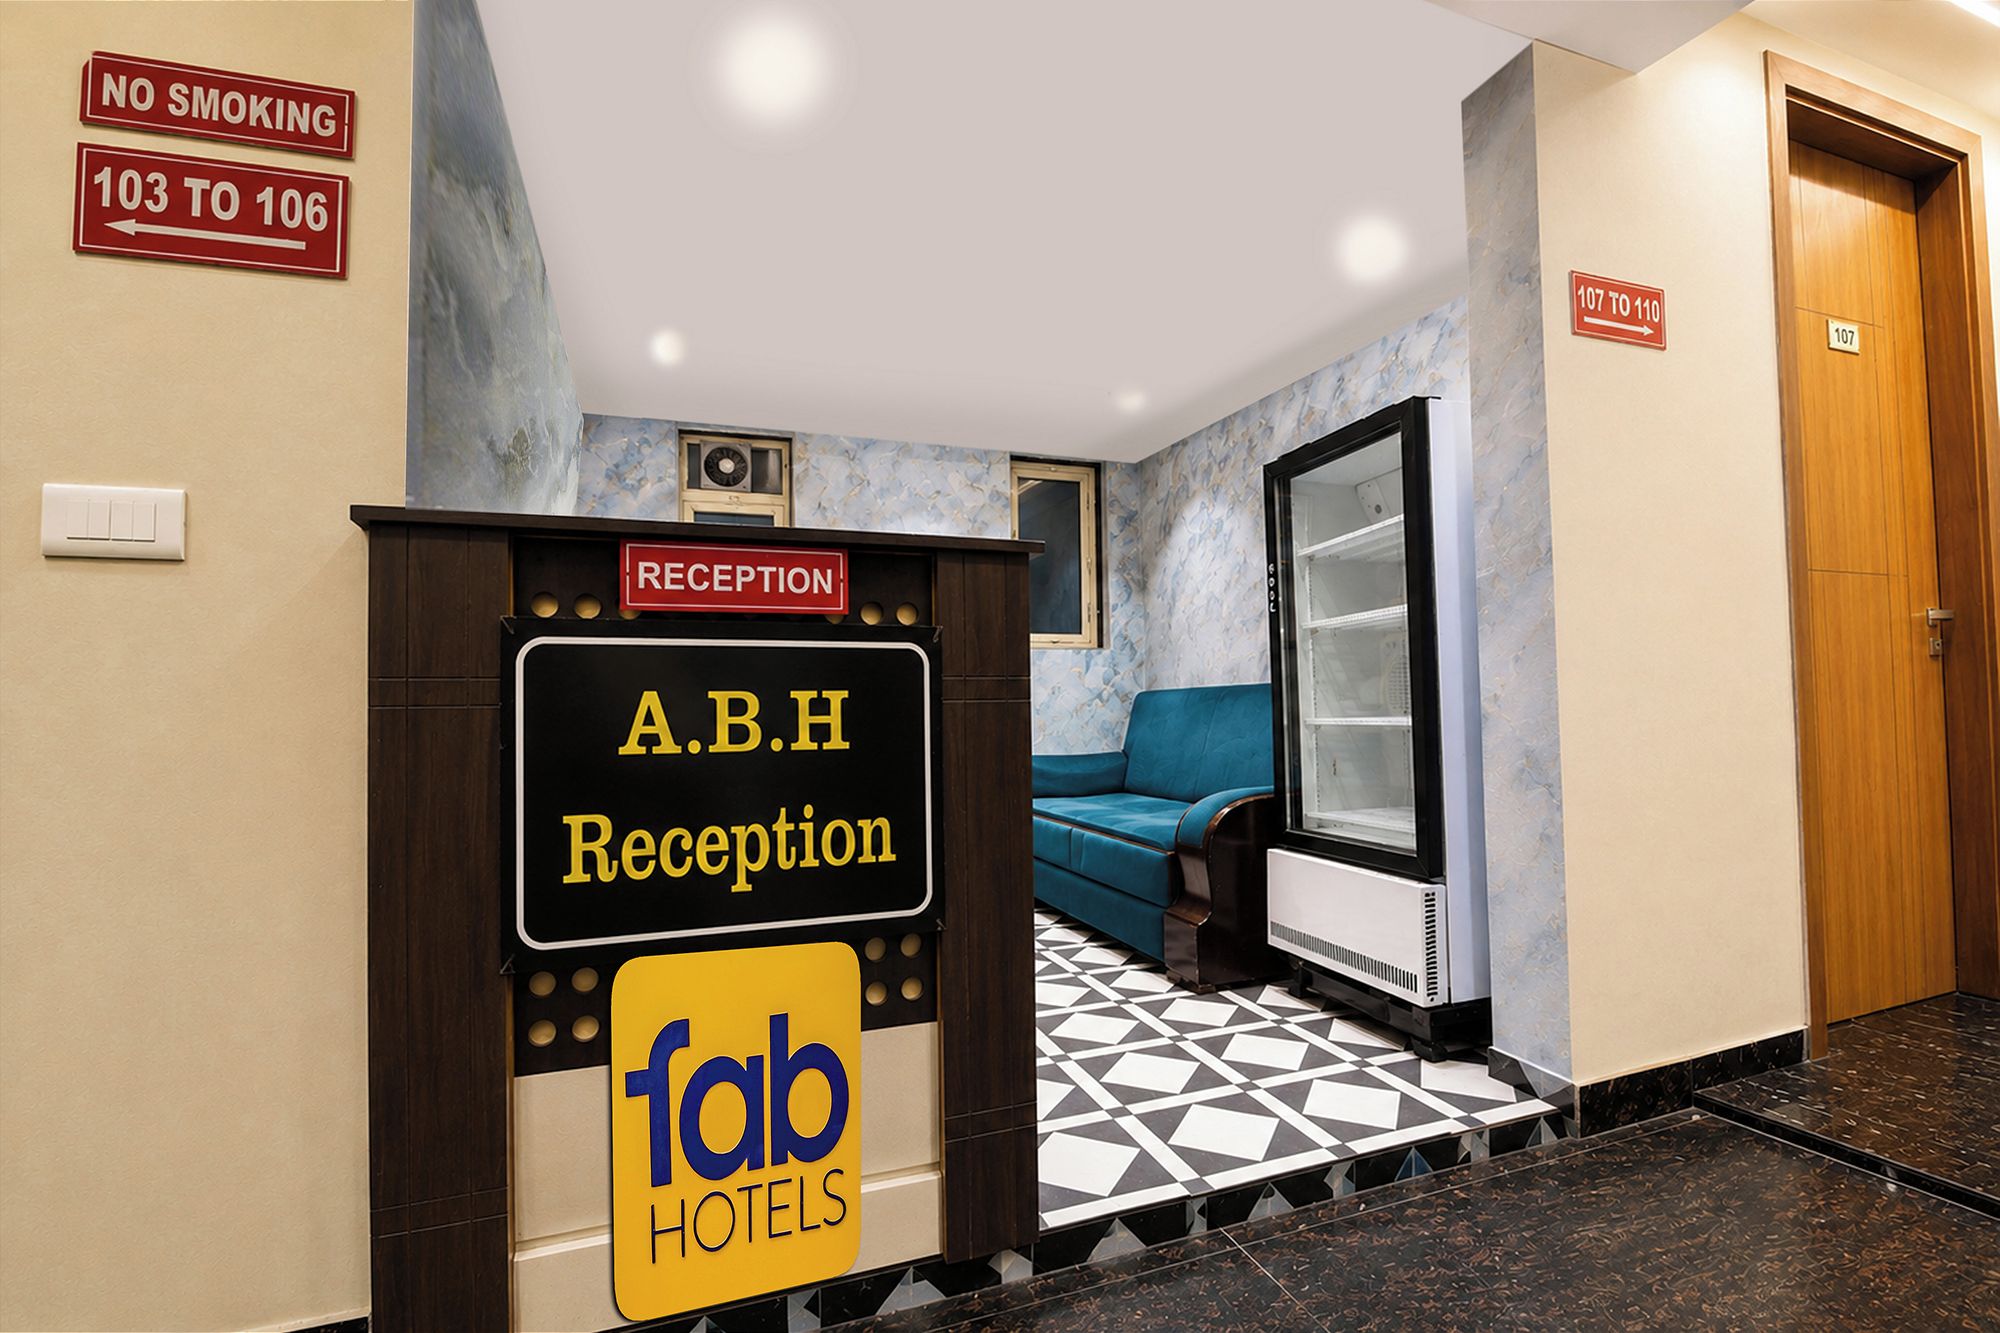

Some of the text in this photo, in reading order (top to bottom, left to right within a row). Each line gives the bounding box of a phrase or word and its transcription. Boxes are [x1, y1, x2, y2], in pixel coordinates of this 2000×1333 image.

[102, 72, 337, 138] NO SMOKING
[94, 166, 329, 232] 103 TO 106
[1577, 284, 1661, 323] 107 TO 110
[1835, 327, 1855, 346] 107
[637, 561, 833, 594] RECEPTION
[618, 690, 850, 755] A.B.H
[562, 804, 897, 893] Reception
[625, 1013, 849, 1188] fab
[650, 1168, 847, 1265] HOTELS
